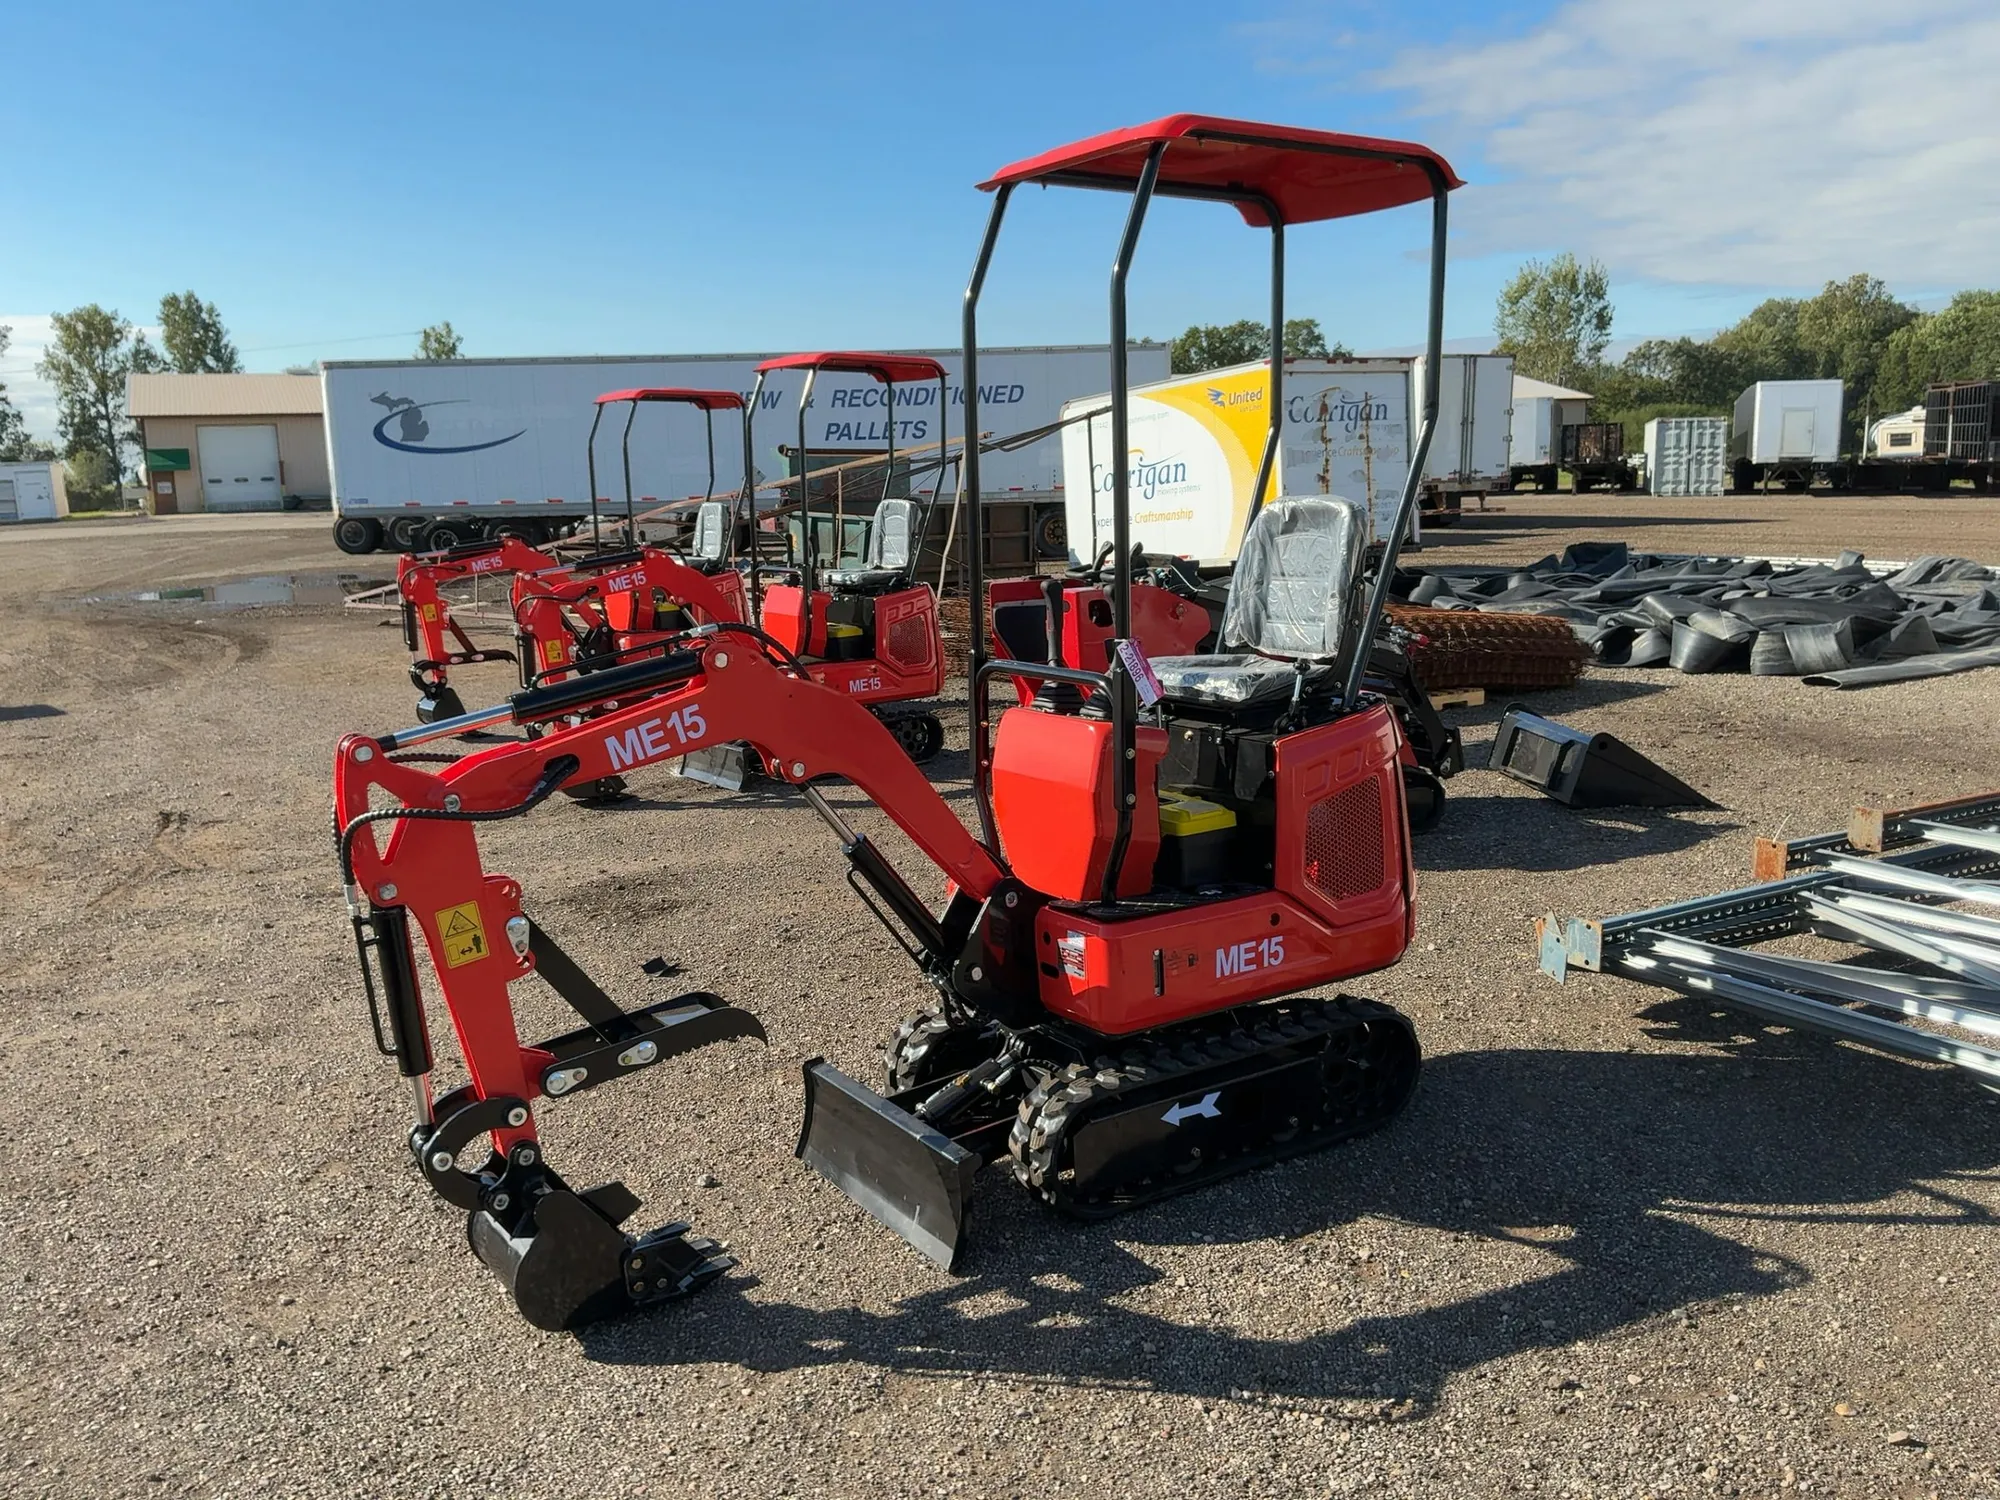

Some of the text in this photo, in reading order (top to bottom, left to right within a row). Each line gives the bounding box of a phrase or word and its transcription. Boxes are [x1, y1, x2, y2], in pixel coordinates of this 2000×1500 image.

[1229, 387, 1262, 405] United
[1288, 395, 1388, 433] Corigan
[824, 420, 928, 441] PALLETS
[1092, 457, 1187, 500] Corigan
[1134, 508, 1194, 524] Craftsmanship
[471, 556, 503, 572] ME15
[608, 571, 647, 593] ME15
[1120, 644, 1145, 683] 2-21896
[848, 677, 882, 693] ME15
[604, 703, 706, 770] ME15
[1215, 935, 1285, 978] ME15
